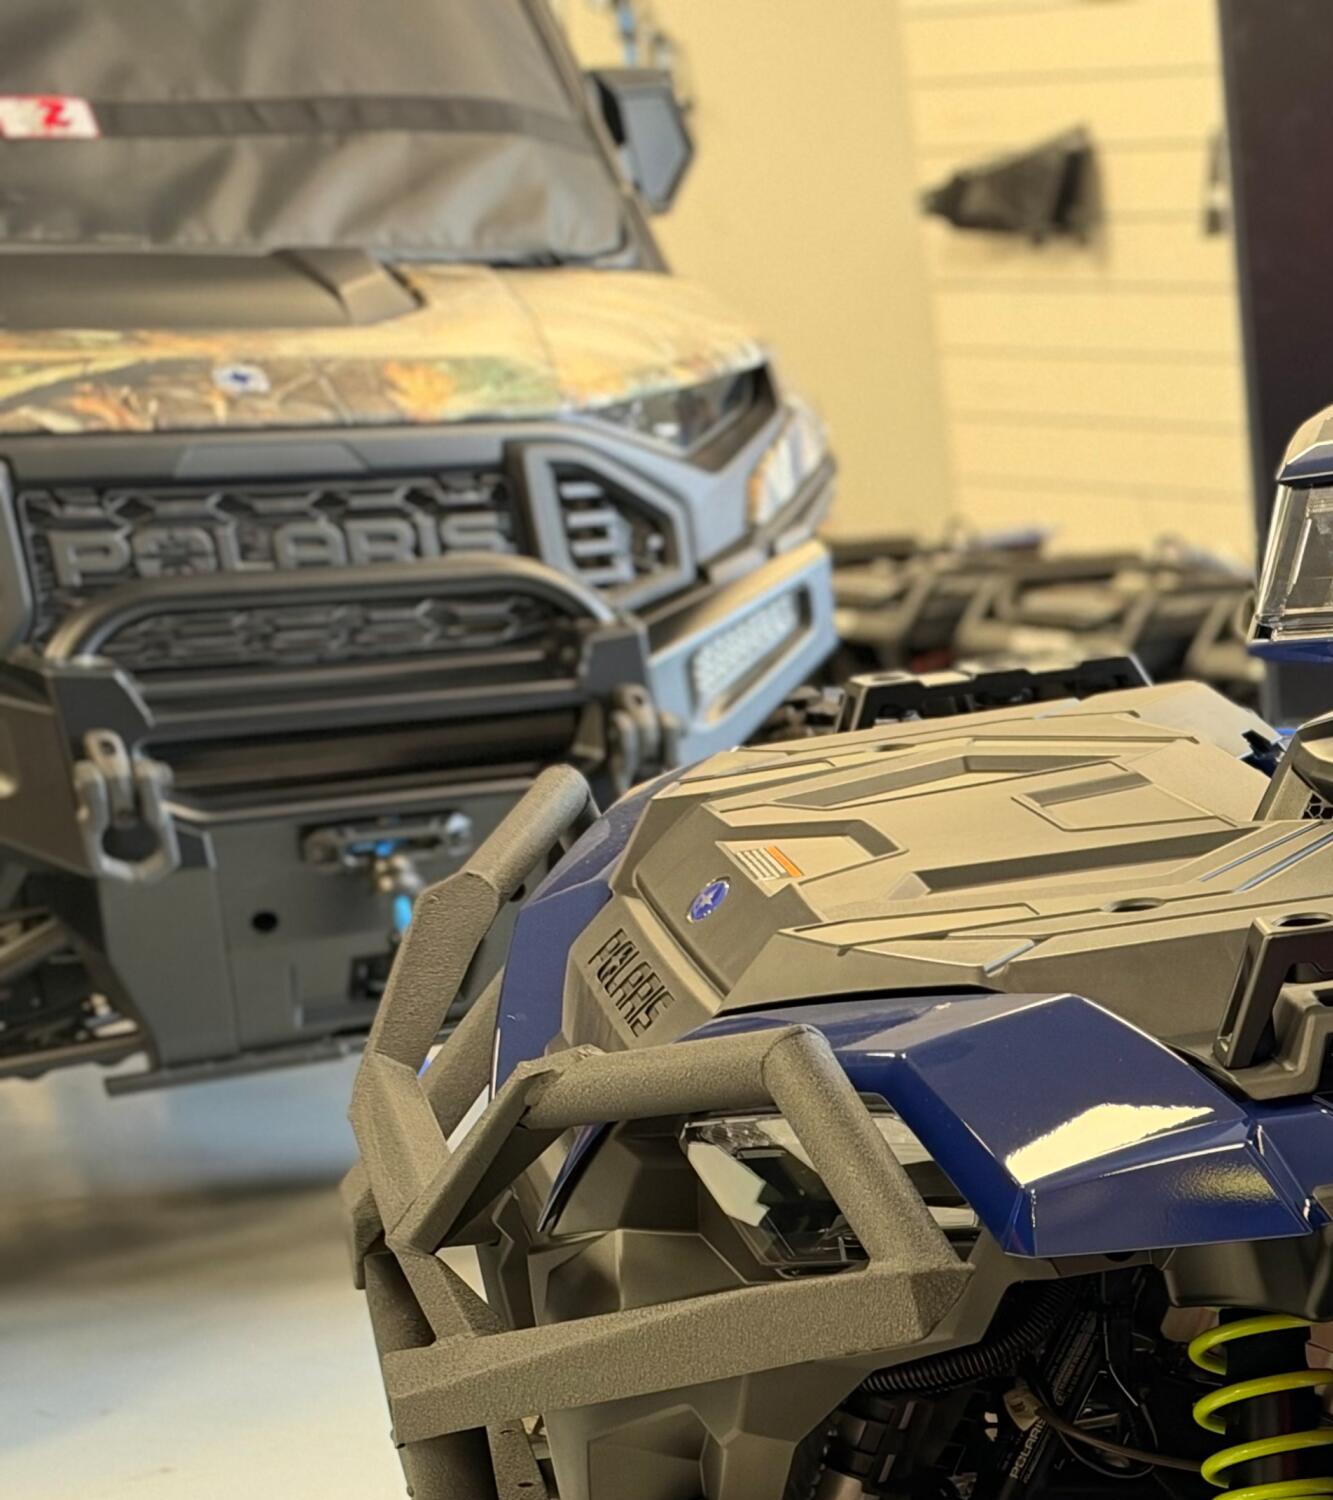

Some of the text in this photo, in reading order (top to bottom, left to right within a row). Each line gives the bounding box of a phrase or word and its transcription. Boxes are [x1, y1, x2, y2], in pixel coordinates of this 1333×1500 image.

[46, 510, 518, 588] POLARIS
[588, 927, 676, 1038] POLARIS
[1009, 1417, 1047, 1479] POLARIS
